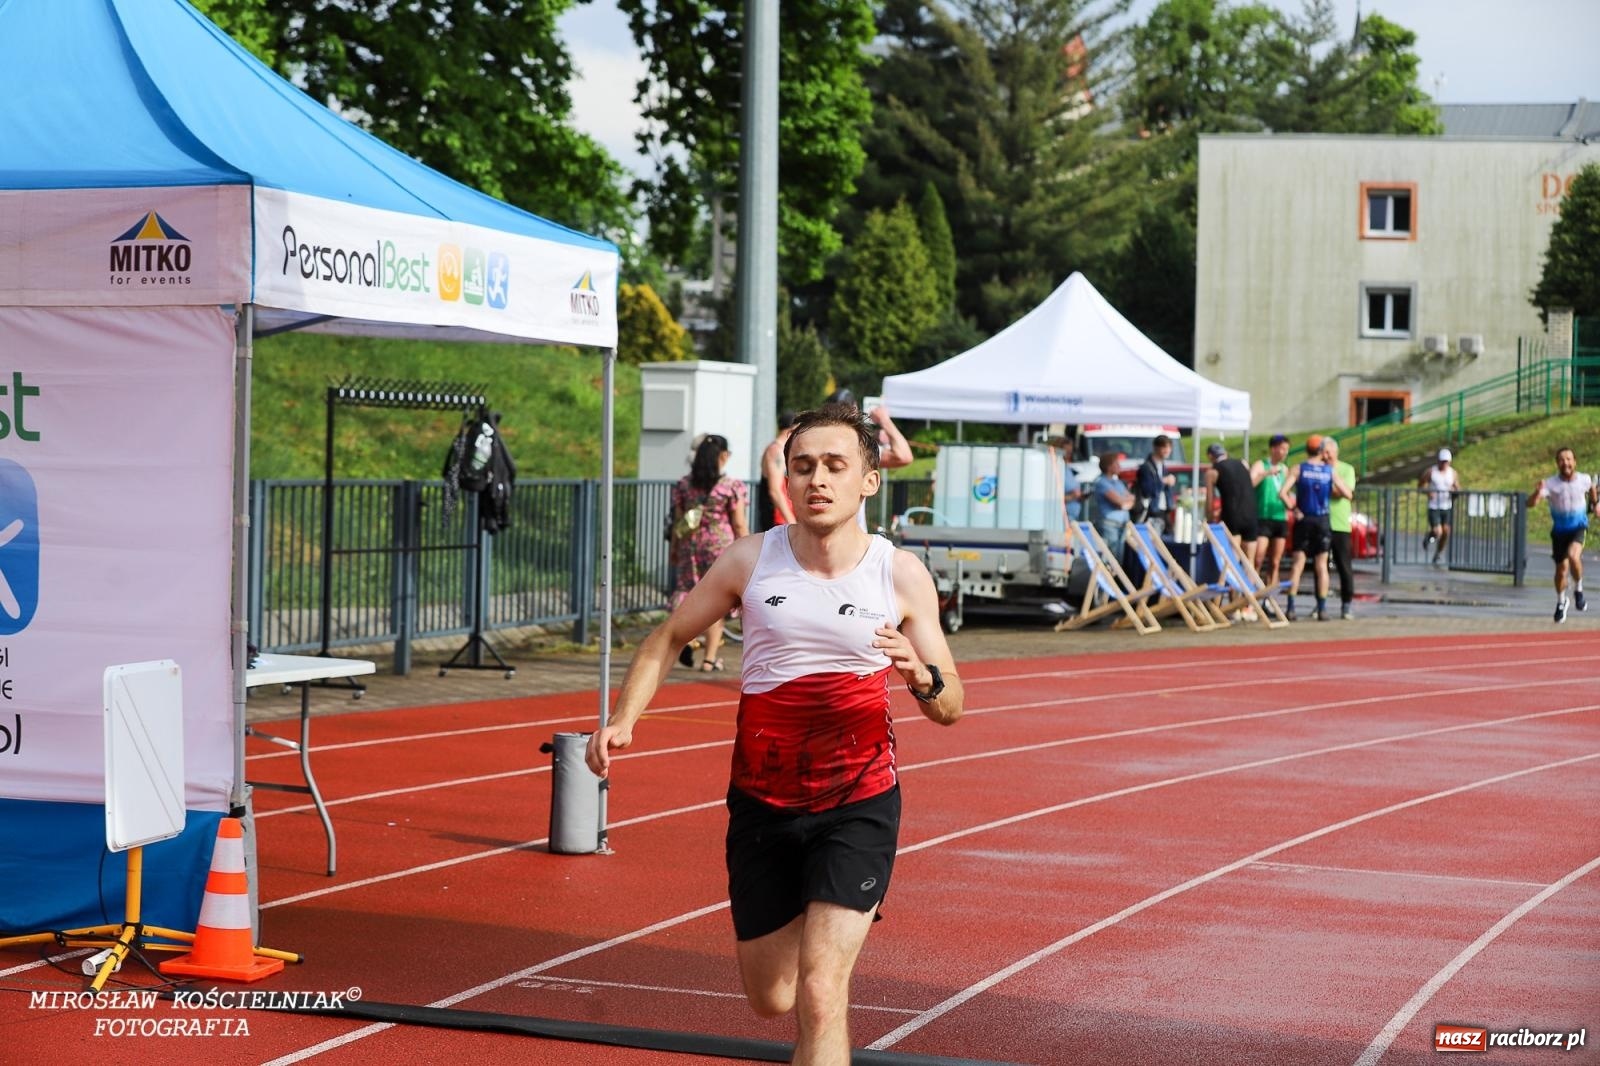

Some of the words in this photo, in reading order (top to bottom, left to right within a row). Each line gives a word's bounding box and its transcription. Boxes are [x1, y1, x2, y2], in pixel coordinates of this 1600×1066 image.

[110, 245, 191, 272] MITKO
[282, 225, 430, 293] PersonalBest
[111, 275, 131, 285] for
[141, 276, 191, 285] events
[570, 293, 600, 316] MITKO
[765, 595, 787, 606] 4F
